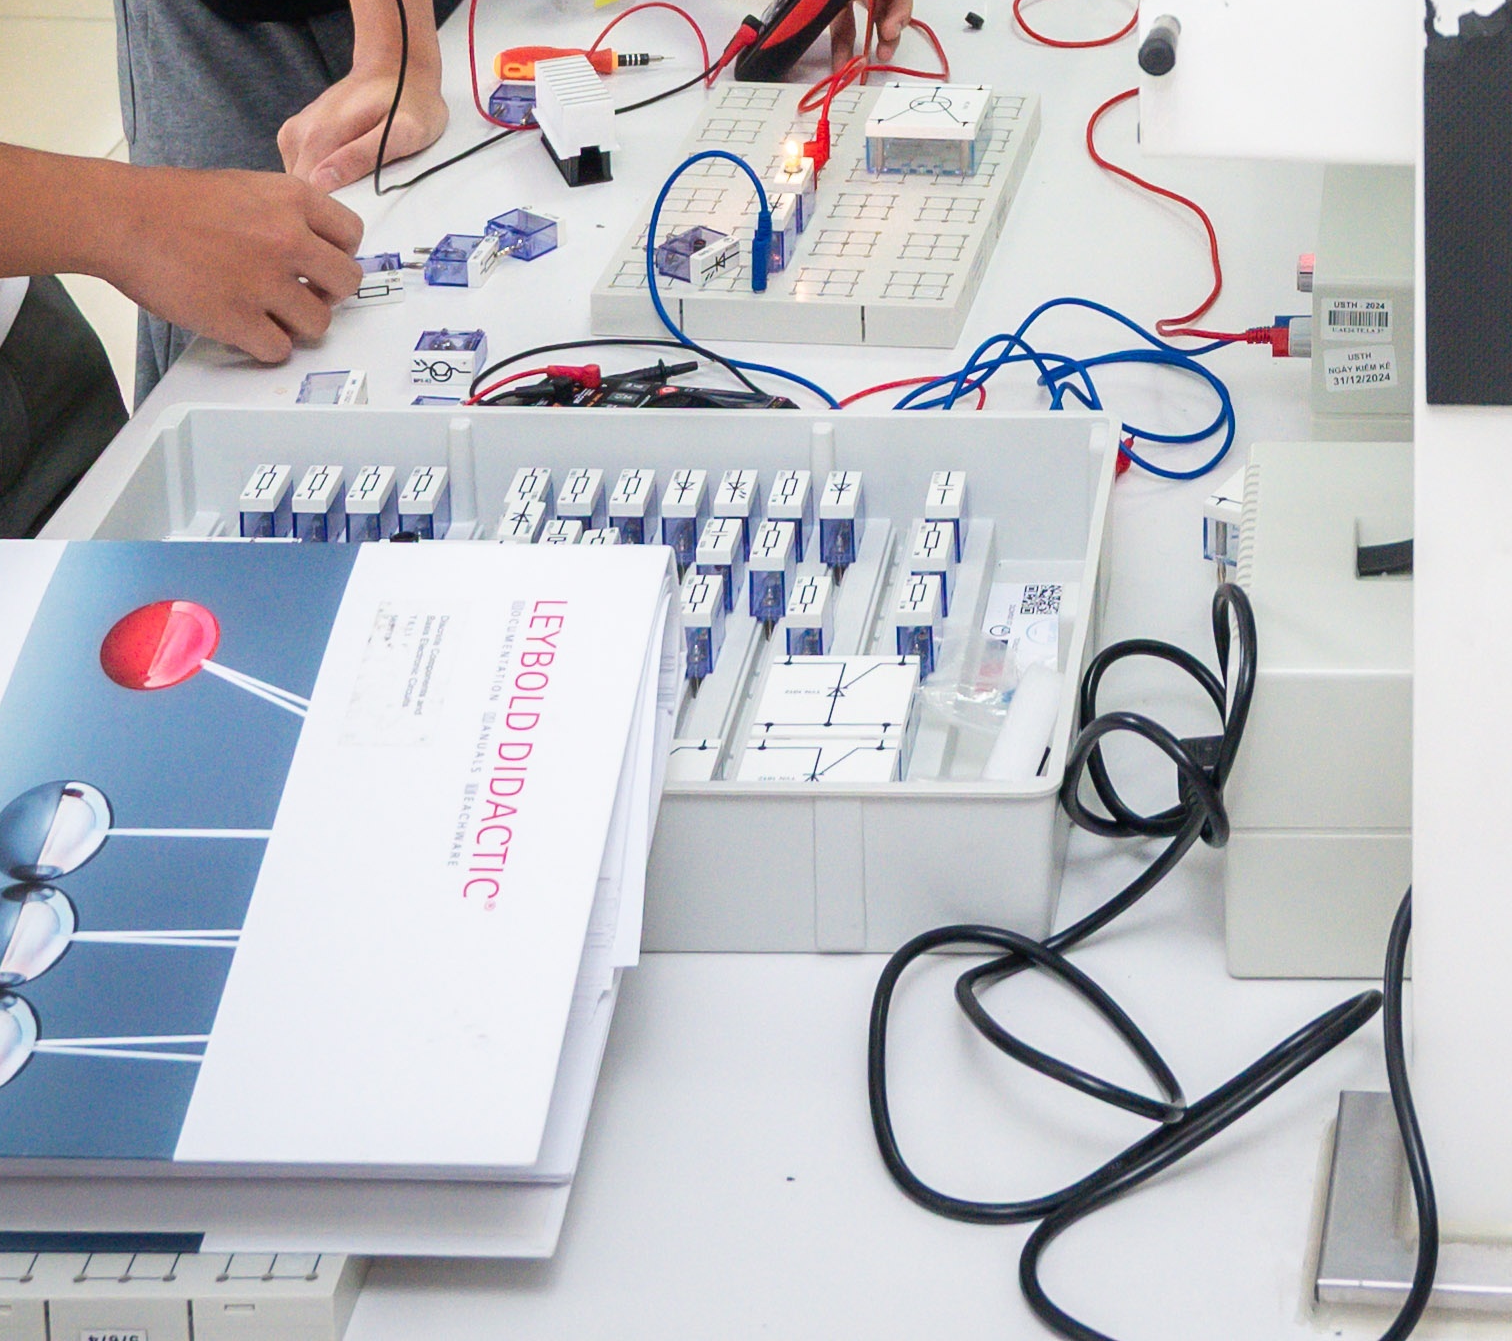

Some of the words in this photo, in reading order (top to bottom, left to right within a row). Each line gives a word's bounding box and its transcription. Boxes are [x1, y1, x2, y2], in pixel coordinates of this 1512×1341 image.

[1333, 301, 1358, 309] USTH
[1365, 302, 1385, 310] 2024
[1347, 352, 1372, 361] USTH
[1333, 373, 1391, 386] 31/12/2024
[506, 600, 568, 731] LEYBOLD
